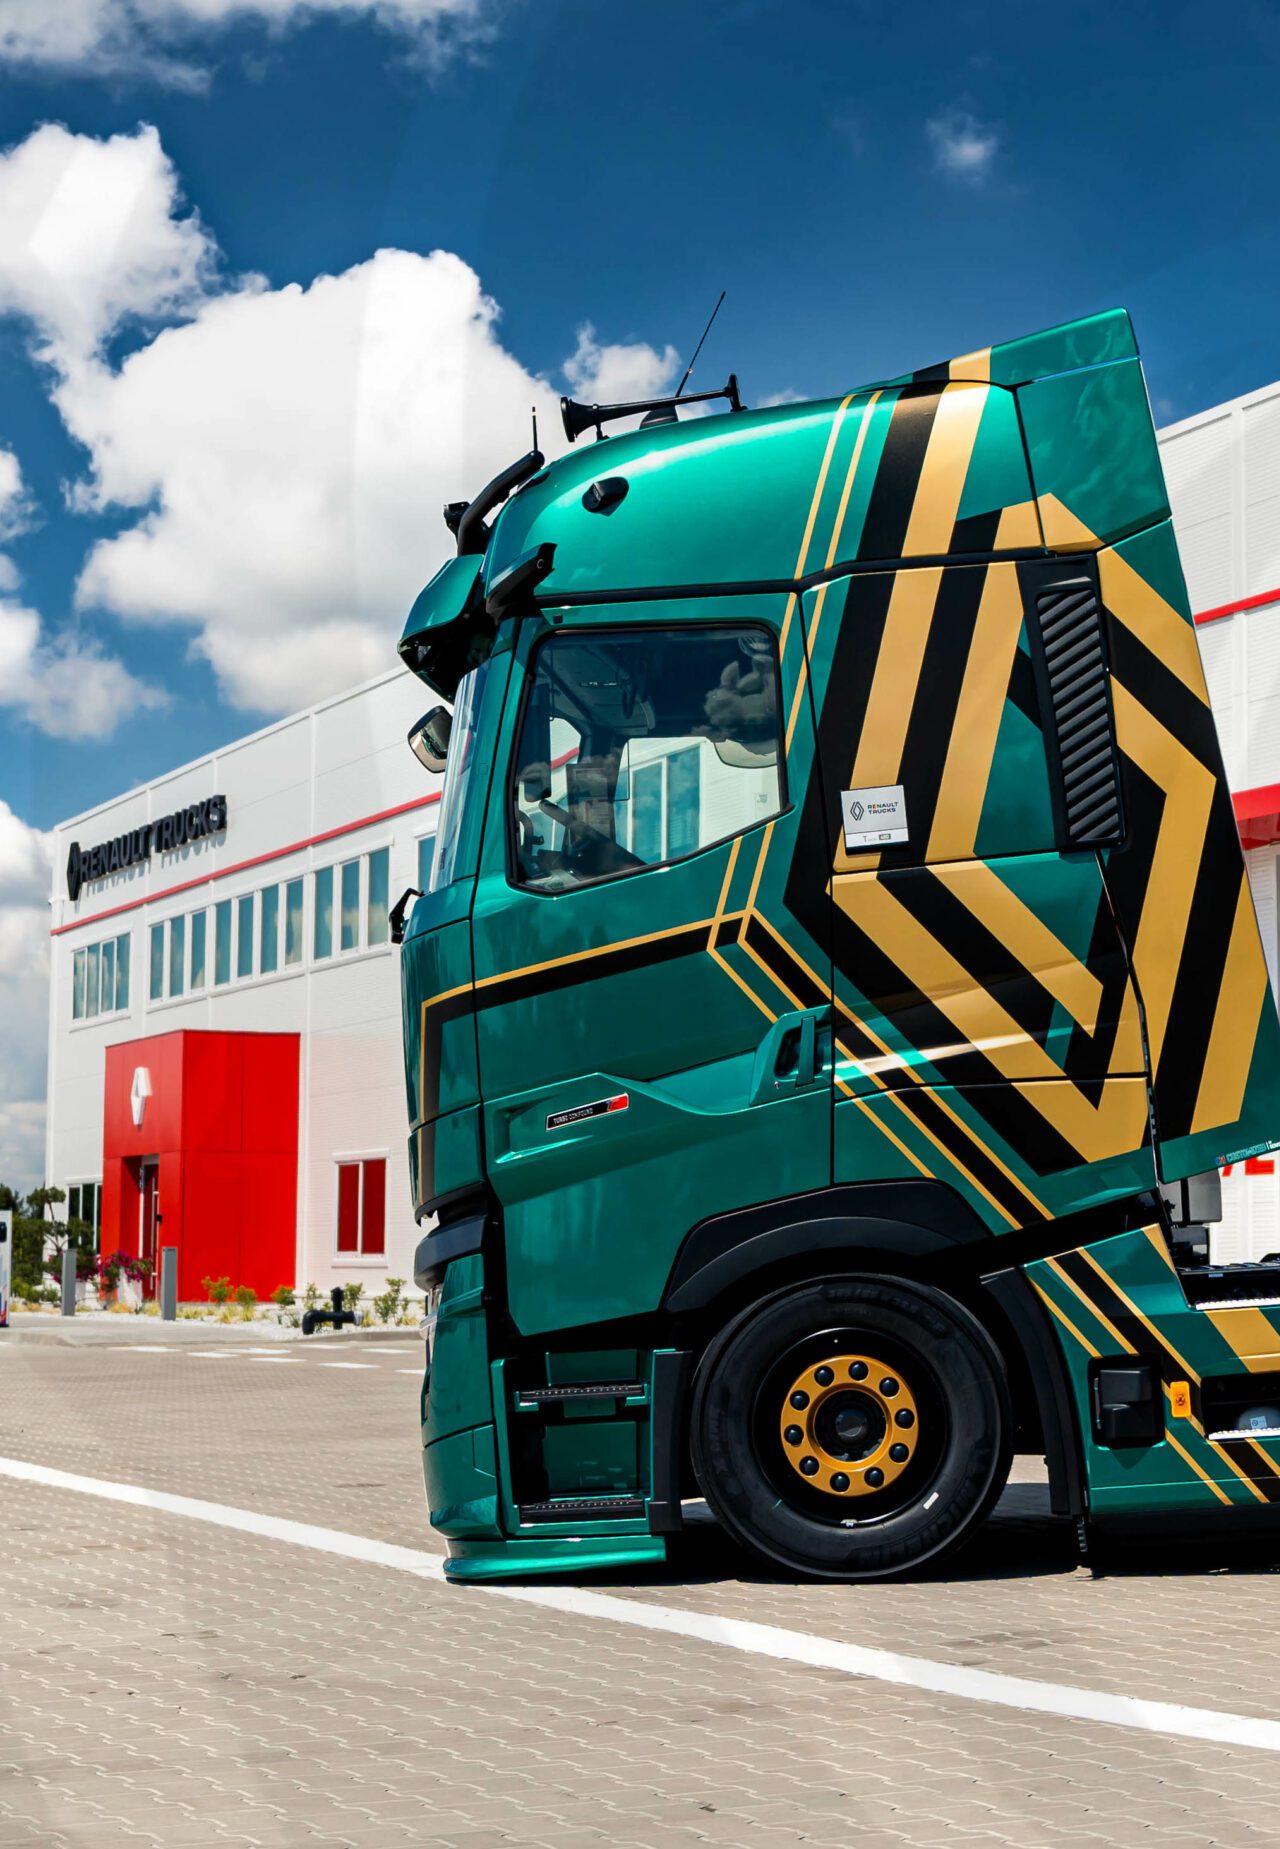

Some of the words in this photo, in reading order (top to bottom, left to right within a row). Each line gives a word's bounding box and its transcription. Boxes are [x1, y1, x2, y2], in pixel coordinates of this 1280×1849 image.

[867, 801, 899, 810] RENAULT
[868, 807, 897, 815] TRUCKS
[80, 824, 152, 883] RENAULT
[152, 794, 228, 854] TRUCKS
